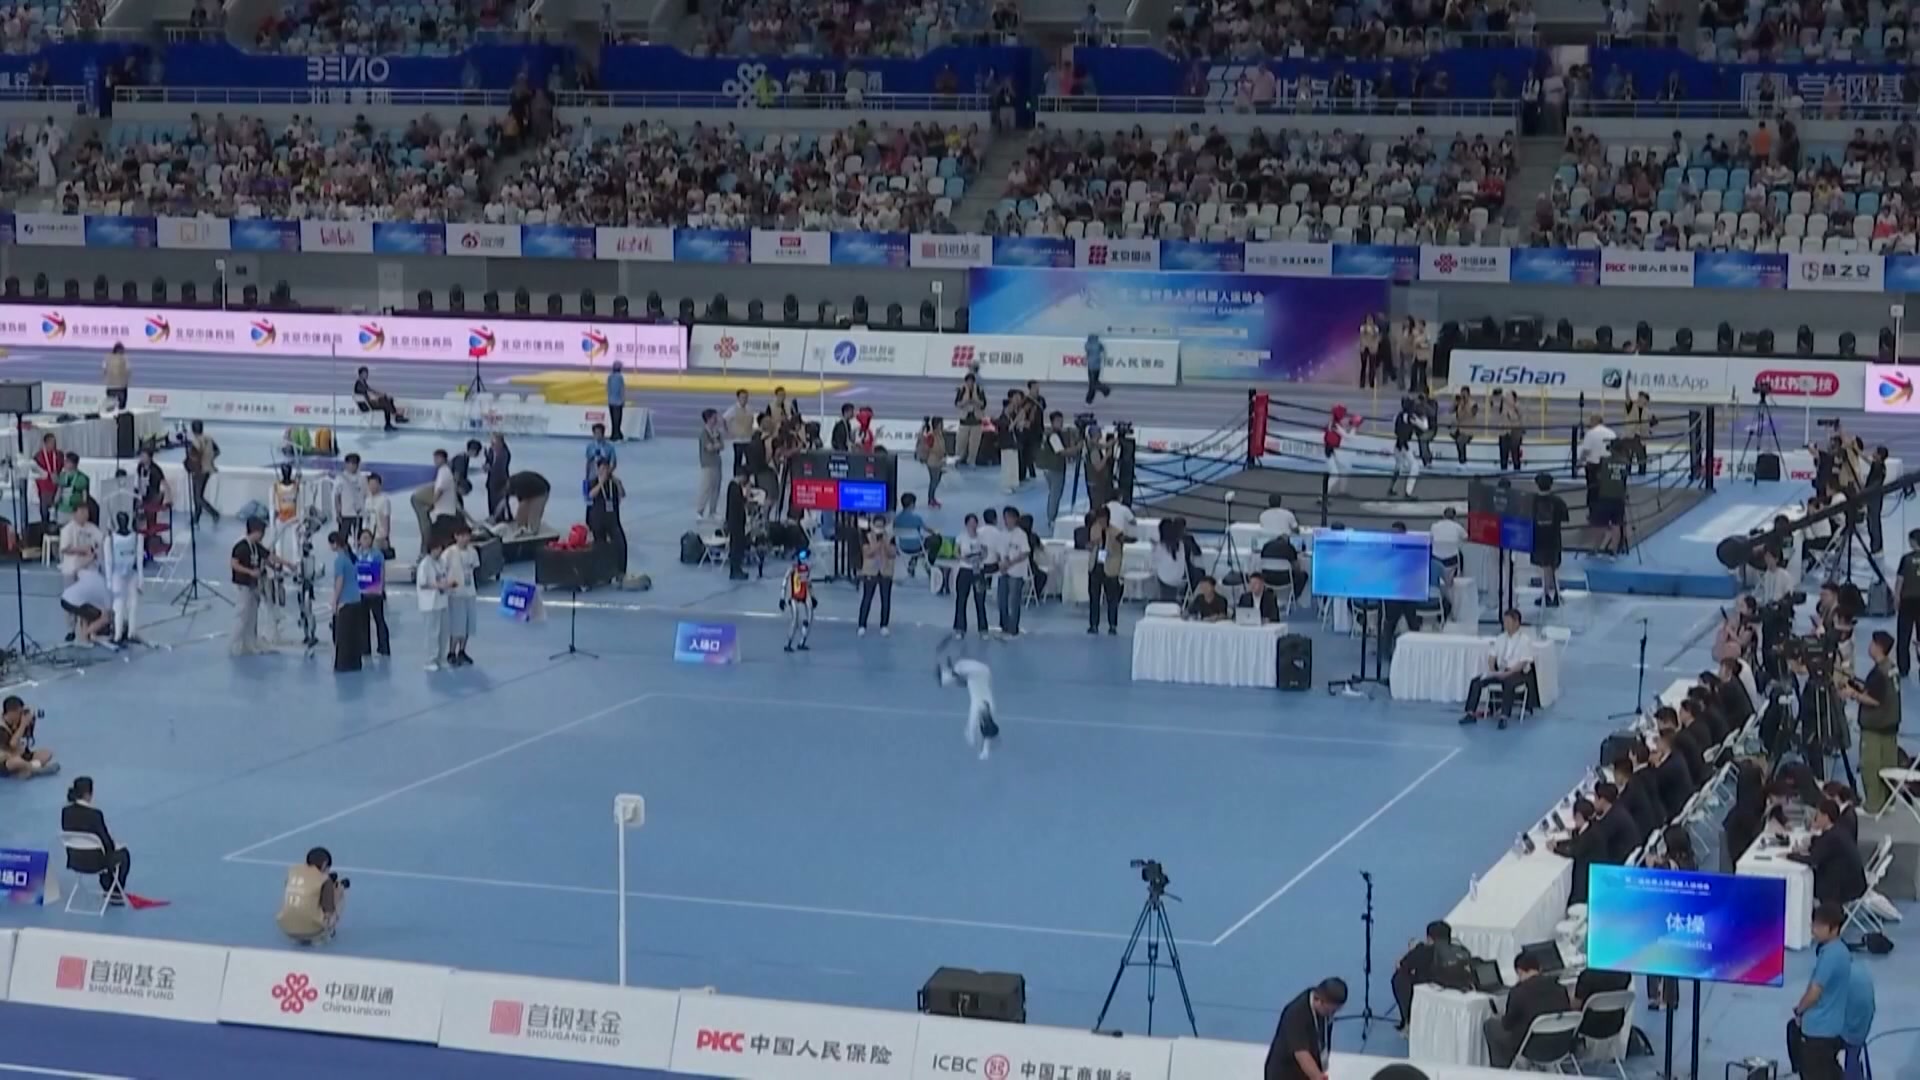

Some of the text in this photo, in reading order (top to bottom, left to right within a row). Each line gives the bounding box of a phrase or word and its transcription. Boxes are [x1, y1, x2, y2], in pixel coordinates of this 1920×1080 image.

[1102, 357, 1164, 369] 国人民保险
[1469, 364, 1567, 386] TaiShan
[0, 868, 28, 887] 场口
[1665, 911, 1704, 935] 体操
[90, 960, 176, 990] 首钢基金
[88, 984, 175, 1001] SHOUGANG FUND
[325, 981, 394, 1005] 中国联通
[527, 1003, 623, 1036] 首钢基金
[526, 1029, 621, 1047] SHOUGANG FUND
[696, 1029, 893, 1066] PICC 中国人民保险
[932, 1053, 978, 1075] ICBC
